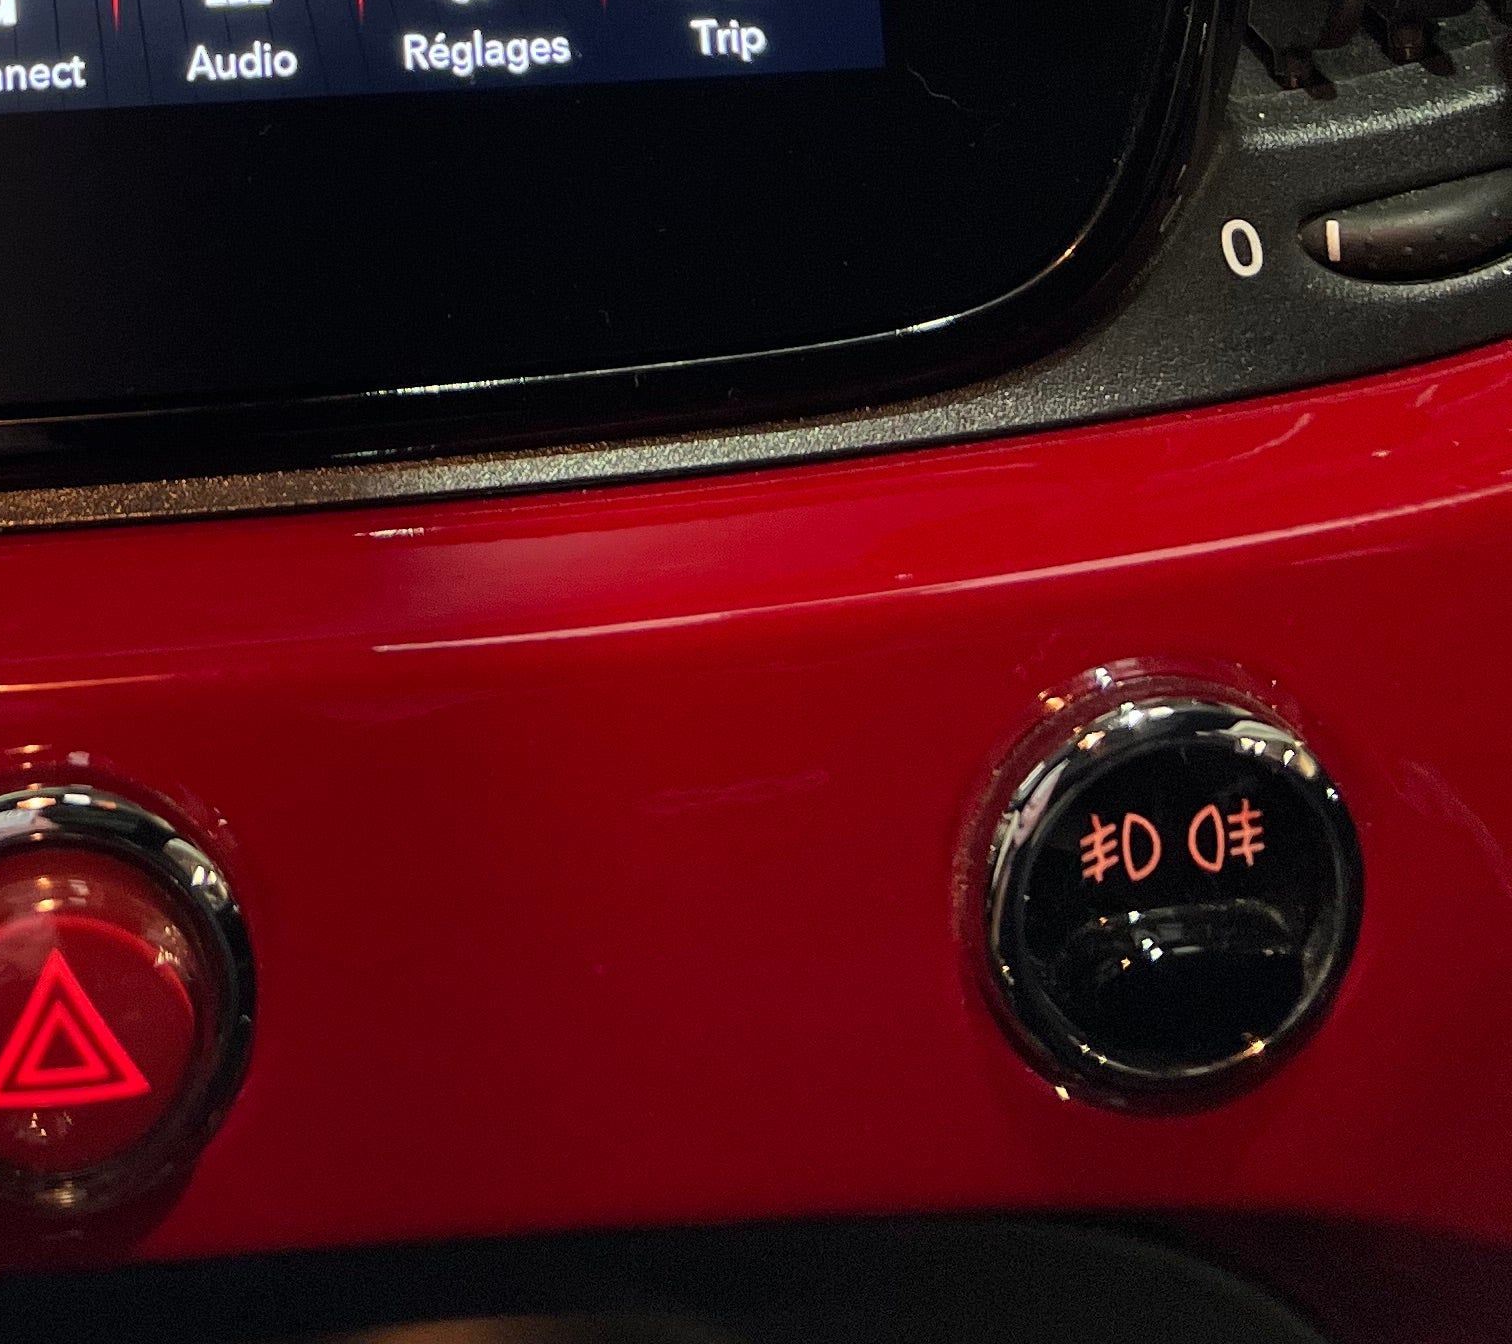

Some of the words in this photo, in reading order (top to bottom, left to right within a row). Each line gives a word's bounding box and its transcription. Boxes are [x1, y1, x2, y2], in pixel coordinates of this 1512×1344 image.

[185, 39, 299, 83] Audio
[402, 28, 572, 78] Réglages
[688, 17, 768, 63] Trip
[1220, 218, 1264, 278] 0
